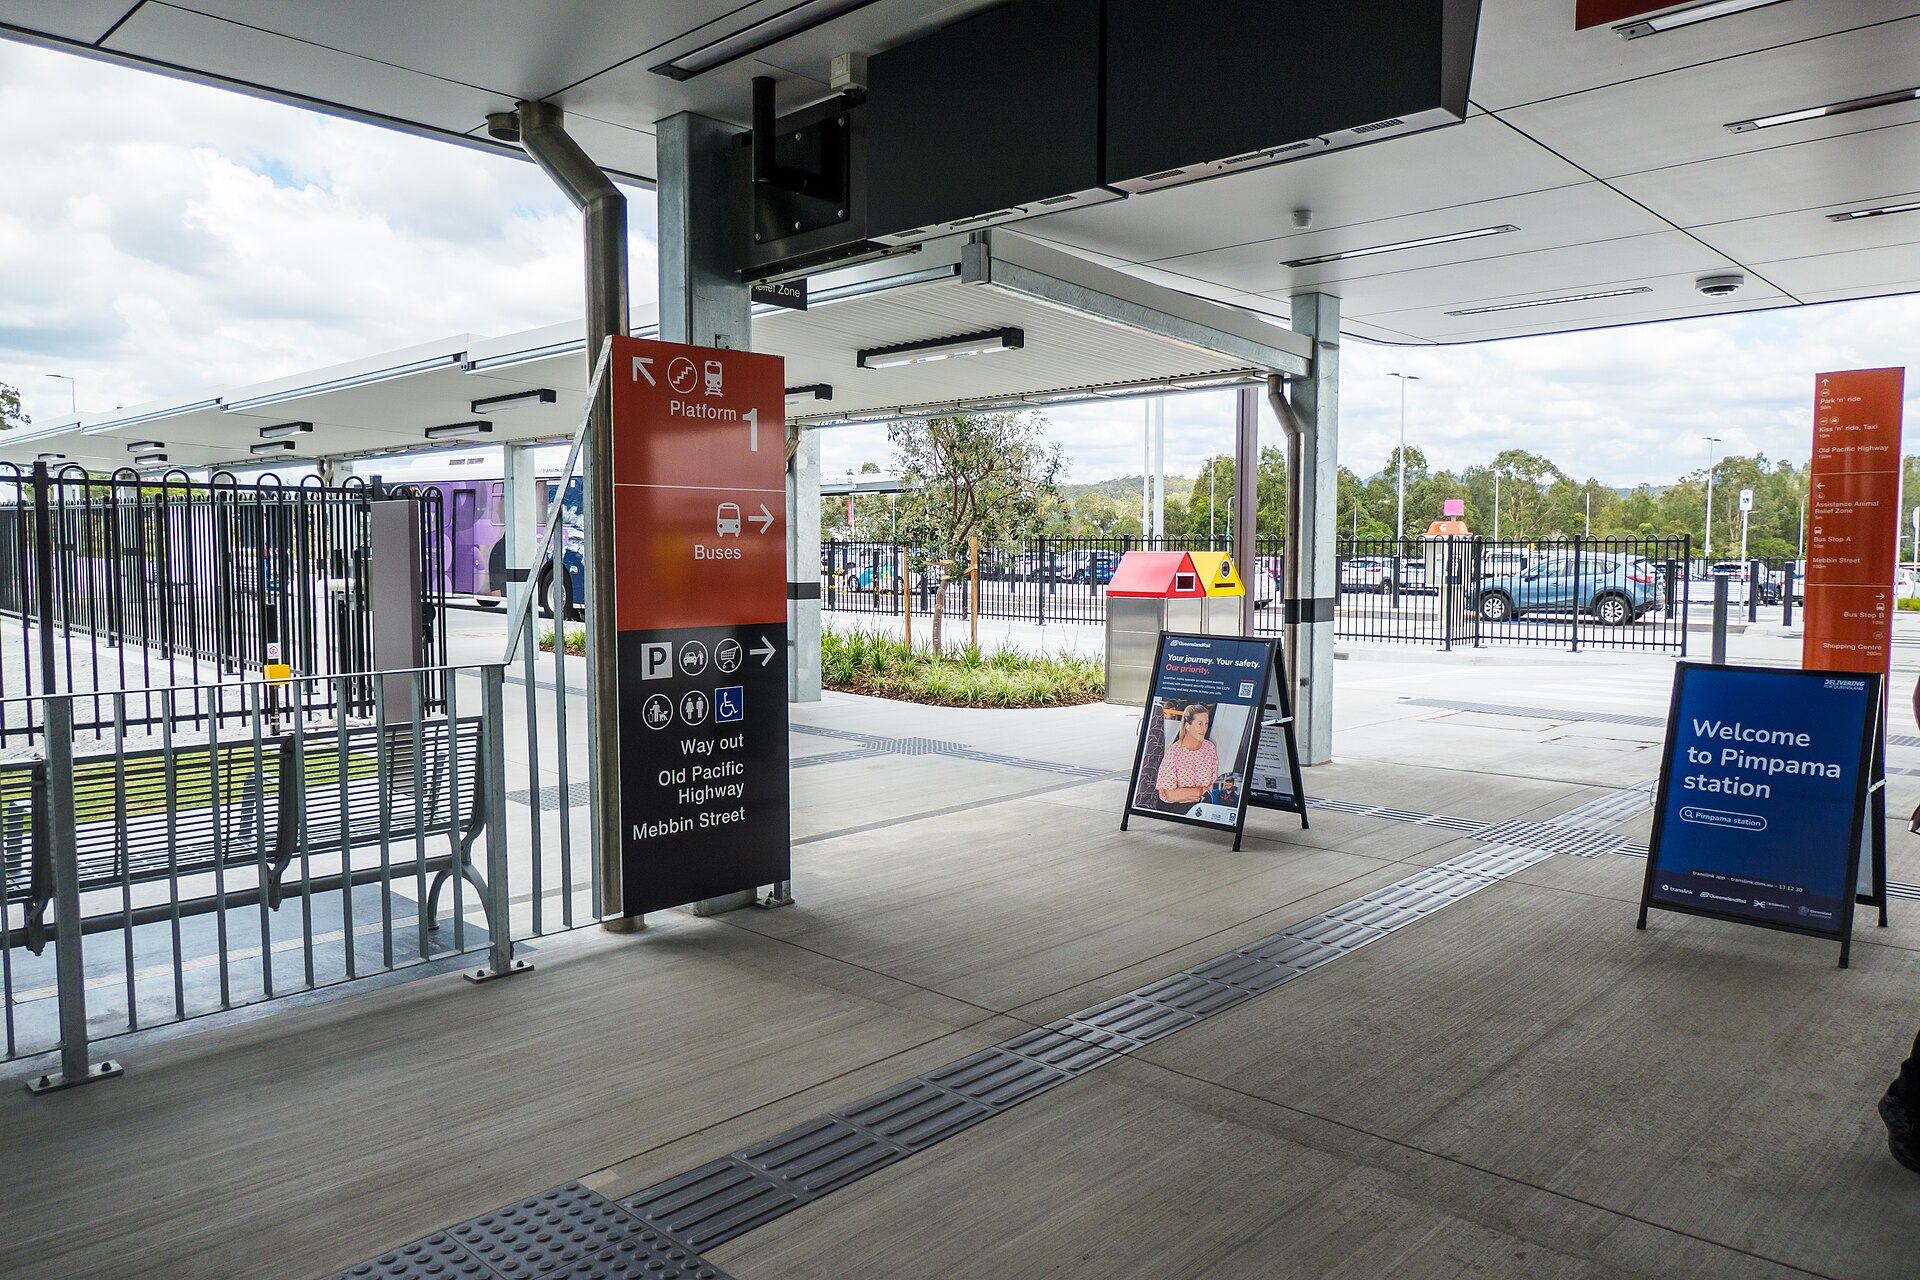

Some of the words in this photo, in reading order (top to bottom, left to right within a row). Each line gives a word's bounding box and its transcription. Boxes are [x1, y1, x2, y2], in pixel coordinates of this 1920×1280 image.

[778, 284, 800, 298] Zone
[670, 400, 737, 421] Platform
[742, 408, 758, 452] 1
[694, 544, 742, 560] Buses
[1823, 643, 1856, 651] Shopping
[1168, 654, 1184, 662] Your
[1184, 655, 1214, 666] journey.
[1217, 658, 1233, 666] Your
[1235, 660, 1261, 669] safety.
[1181, 665, 1210, 675] priority.
[1693, 718, 1811, 747] Welcome
[681, 739, 715, 756] Way
[720, 734, 744, 750] out
[1687, 747, 1713, 765] to
[1721, 749, 1841, 779] Pimpama
[659, 768, 686, 786] Old
[693, 761, 744, 782] Pacific
[679, 783, 745, 805] Highway
[1684, 774, 1771, 799] station
[633, 817, 694, 840] Mebbin
[700, 807, 745, 828] Street
[1696, 812, 1732, 823] Pimpama
[1734, 819, 1761, 827] station
[1693, 871, 1715, 879] translink
[1670, 886, 1694, 895] translink
